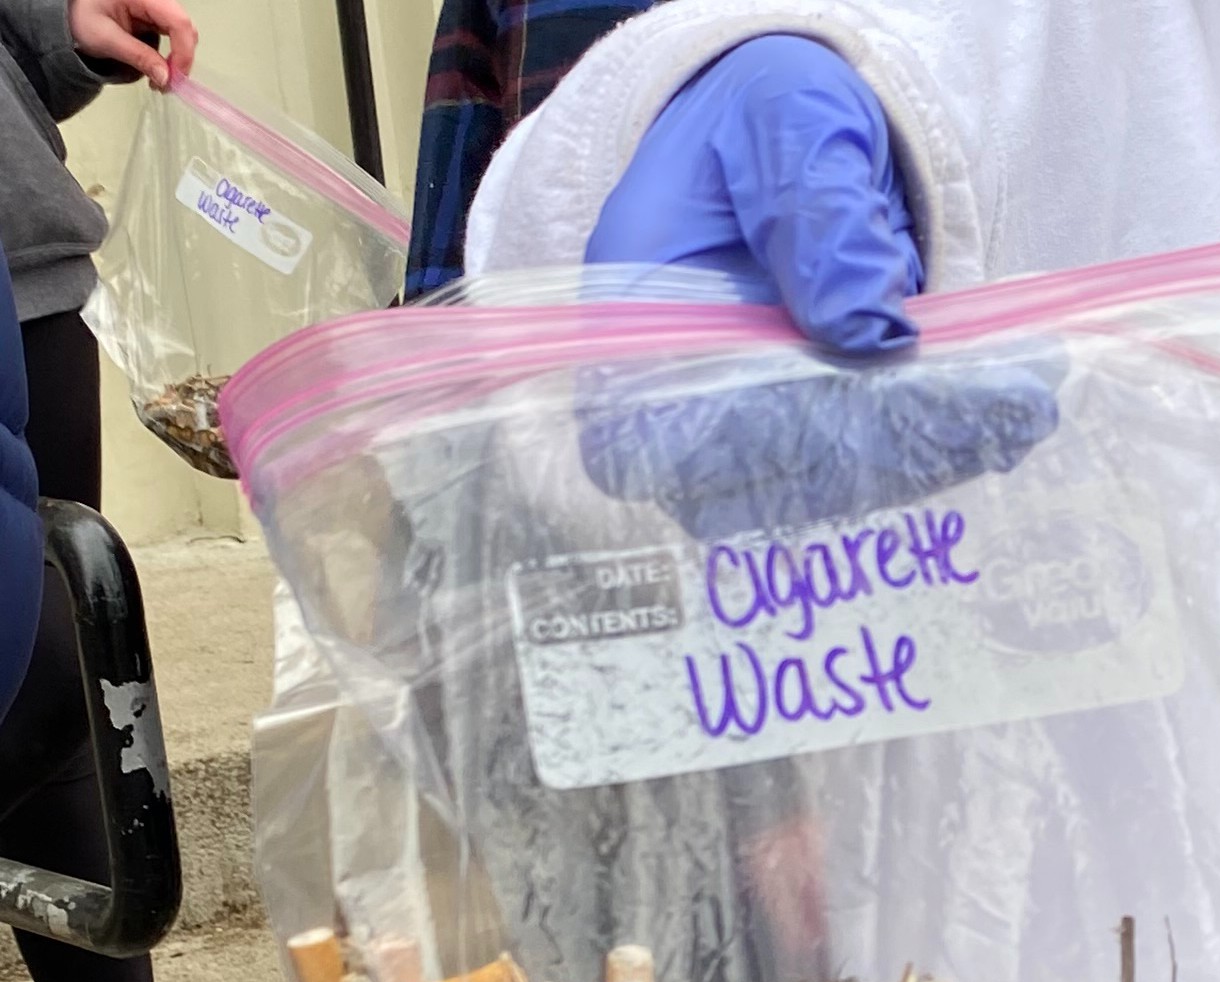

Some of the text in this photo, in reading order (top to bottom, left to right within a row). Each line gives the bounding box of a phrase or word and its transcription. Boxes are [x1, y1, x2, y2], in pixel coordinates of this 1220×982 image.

[197, 191, 240, 234] Waste
[529, 605, 680, 640] CONTENTS:
[684, 626, 931, 738] Waste
